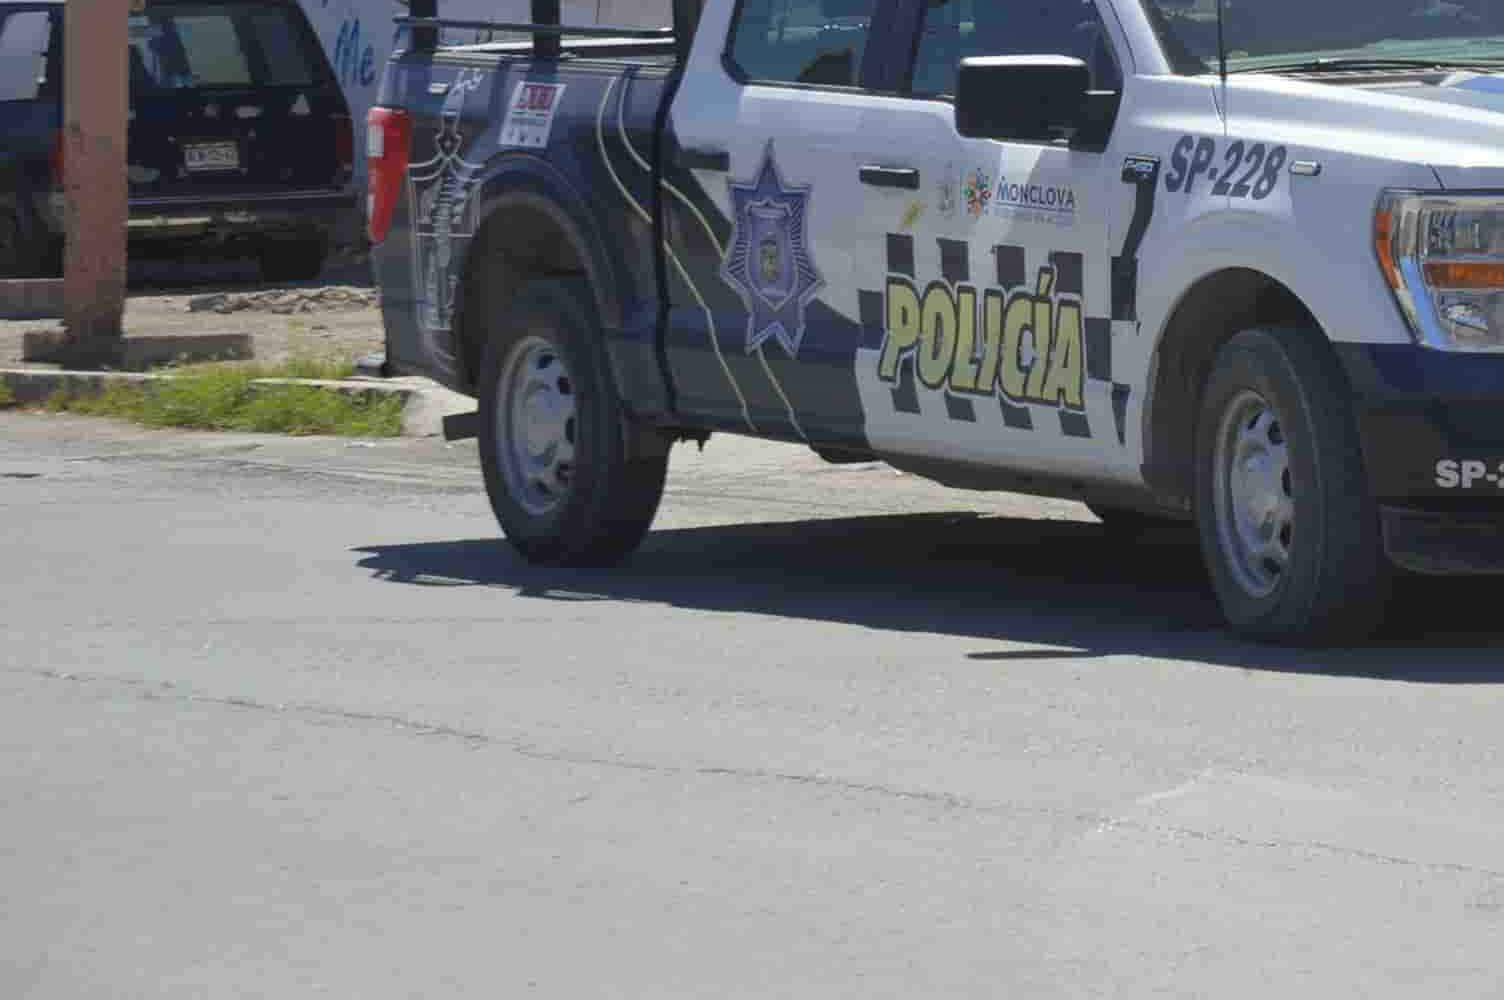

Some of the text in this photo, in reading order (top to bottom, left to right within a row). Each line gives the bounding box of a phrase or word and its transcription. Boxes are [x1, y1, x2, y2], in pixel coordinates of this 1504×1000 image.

[996, 176, 1076, 208] MONCLOVA
[1165, 135, 1287, 200] SP-228
[879, 264, 1086, 413] POLICÍA
